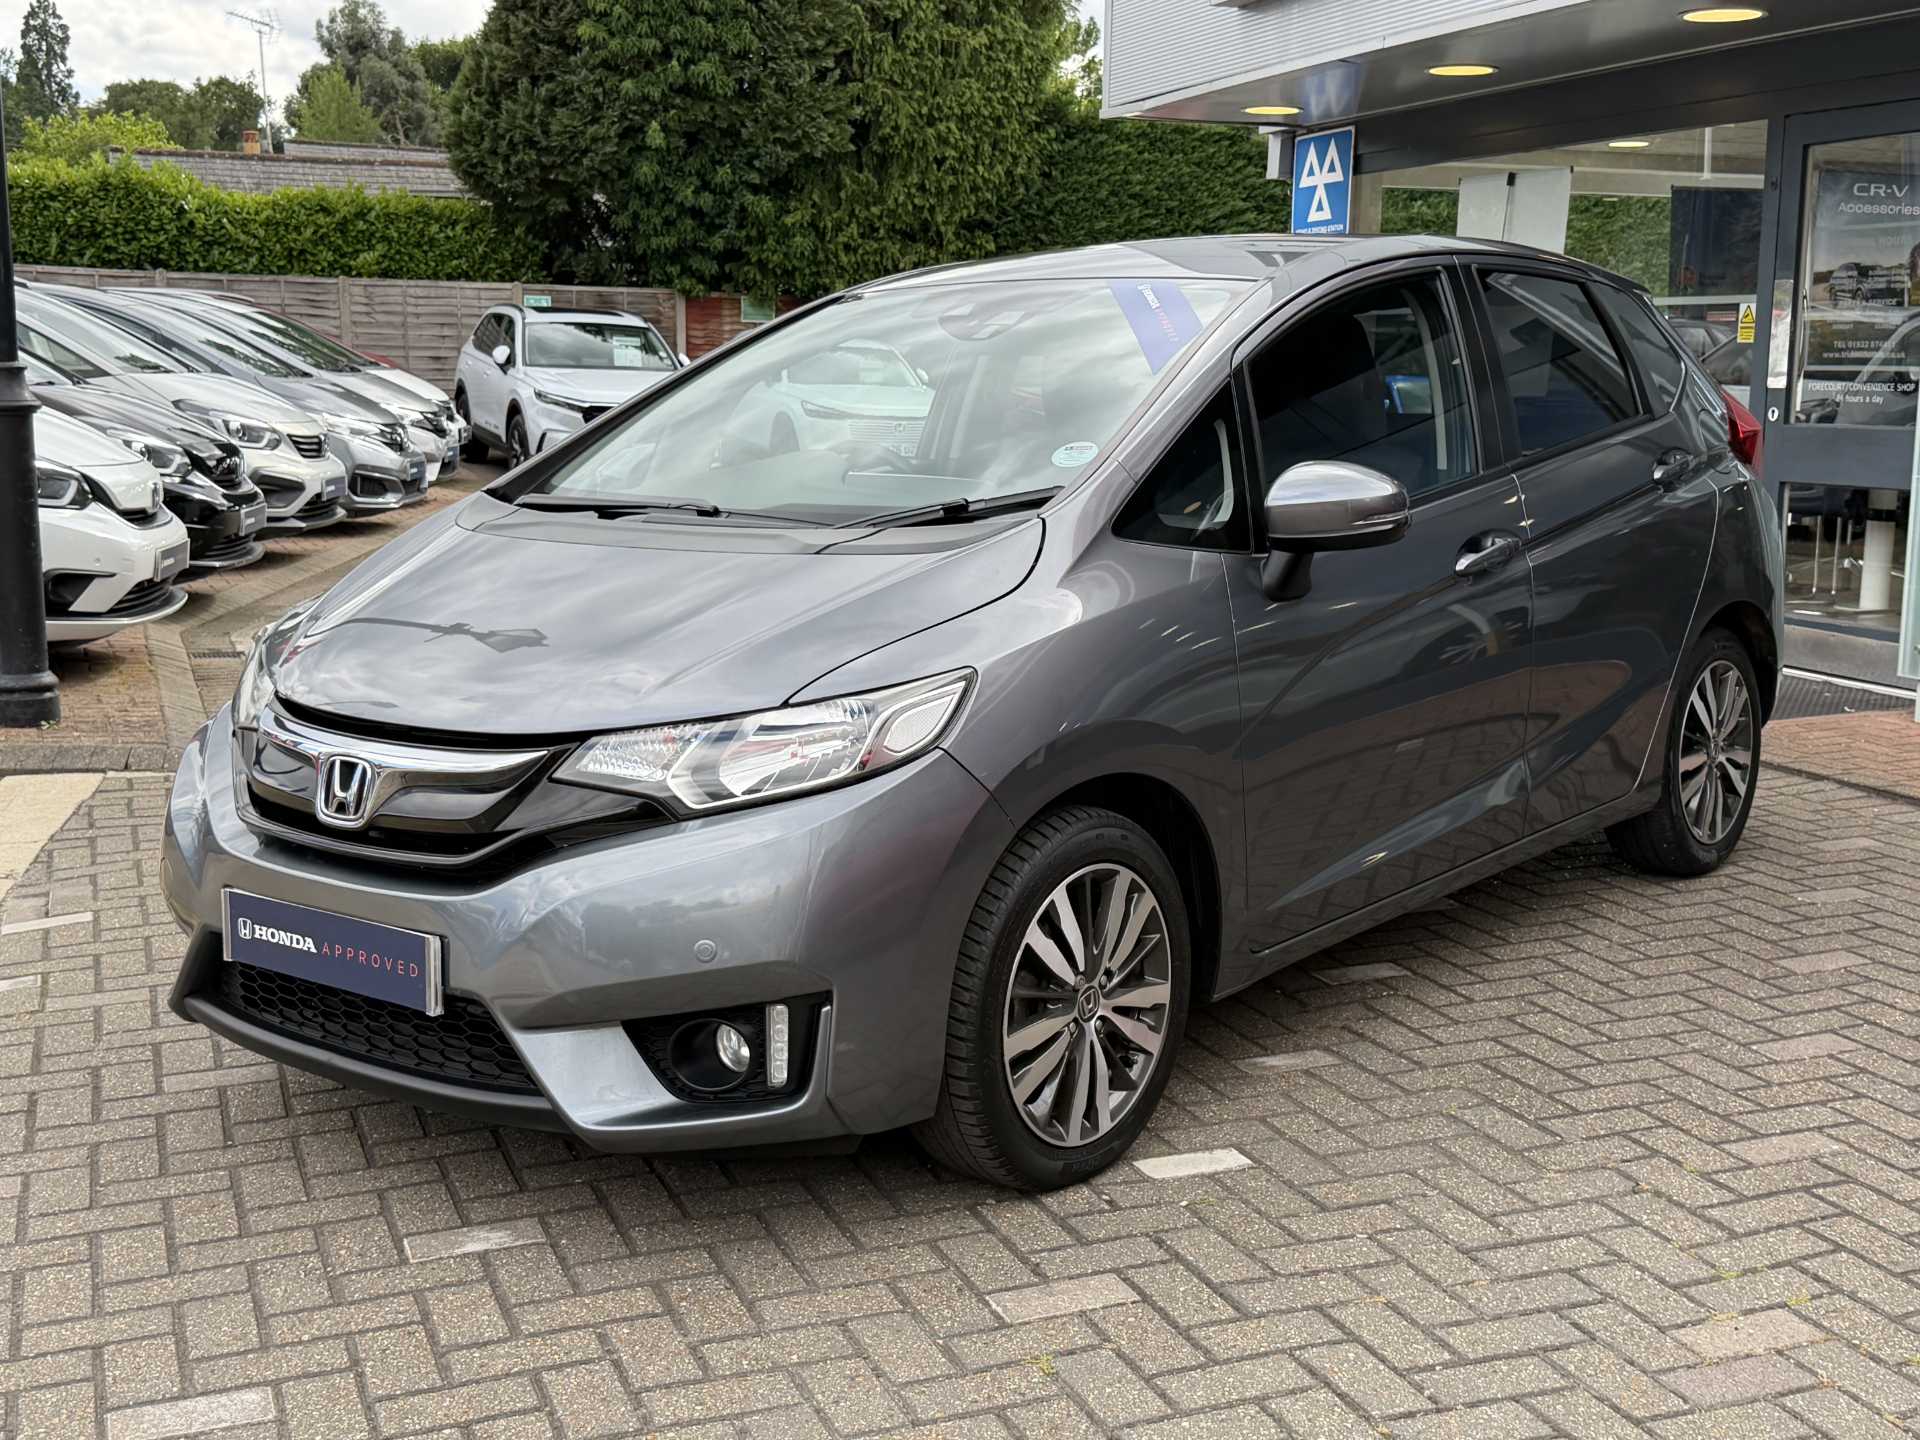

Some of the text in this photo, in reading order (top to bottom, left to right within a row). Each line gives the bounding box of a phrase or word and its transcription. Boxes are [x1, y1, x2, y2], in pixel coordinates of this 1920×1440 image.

[1853, 183, 1909, 198] CR-V
[1838, 202, 1920, 216] Accessories
[1896, 383, 1916, 392] SHOP
[1845, 393, 1864, 403] hours
[1872, 393, 1884, 406] day
[253, 924, 317, 953] HONDA
[321, 942, 418, 977] APPROVED
